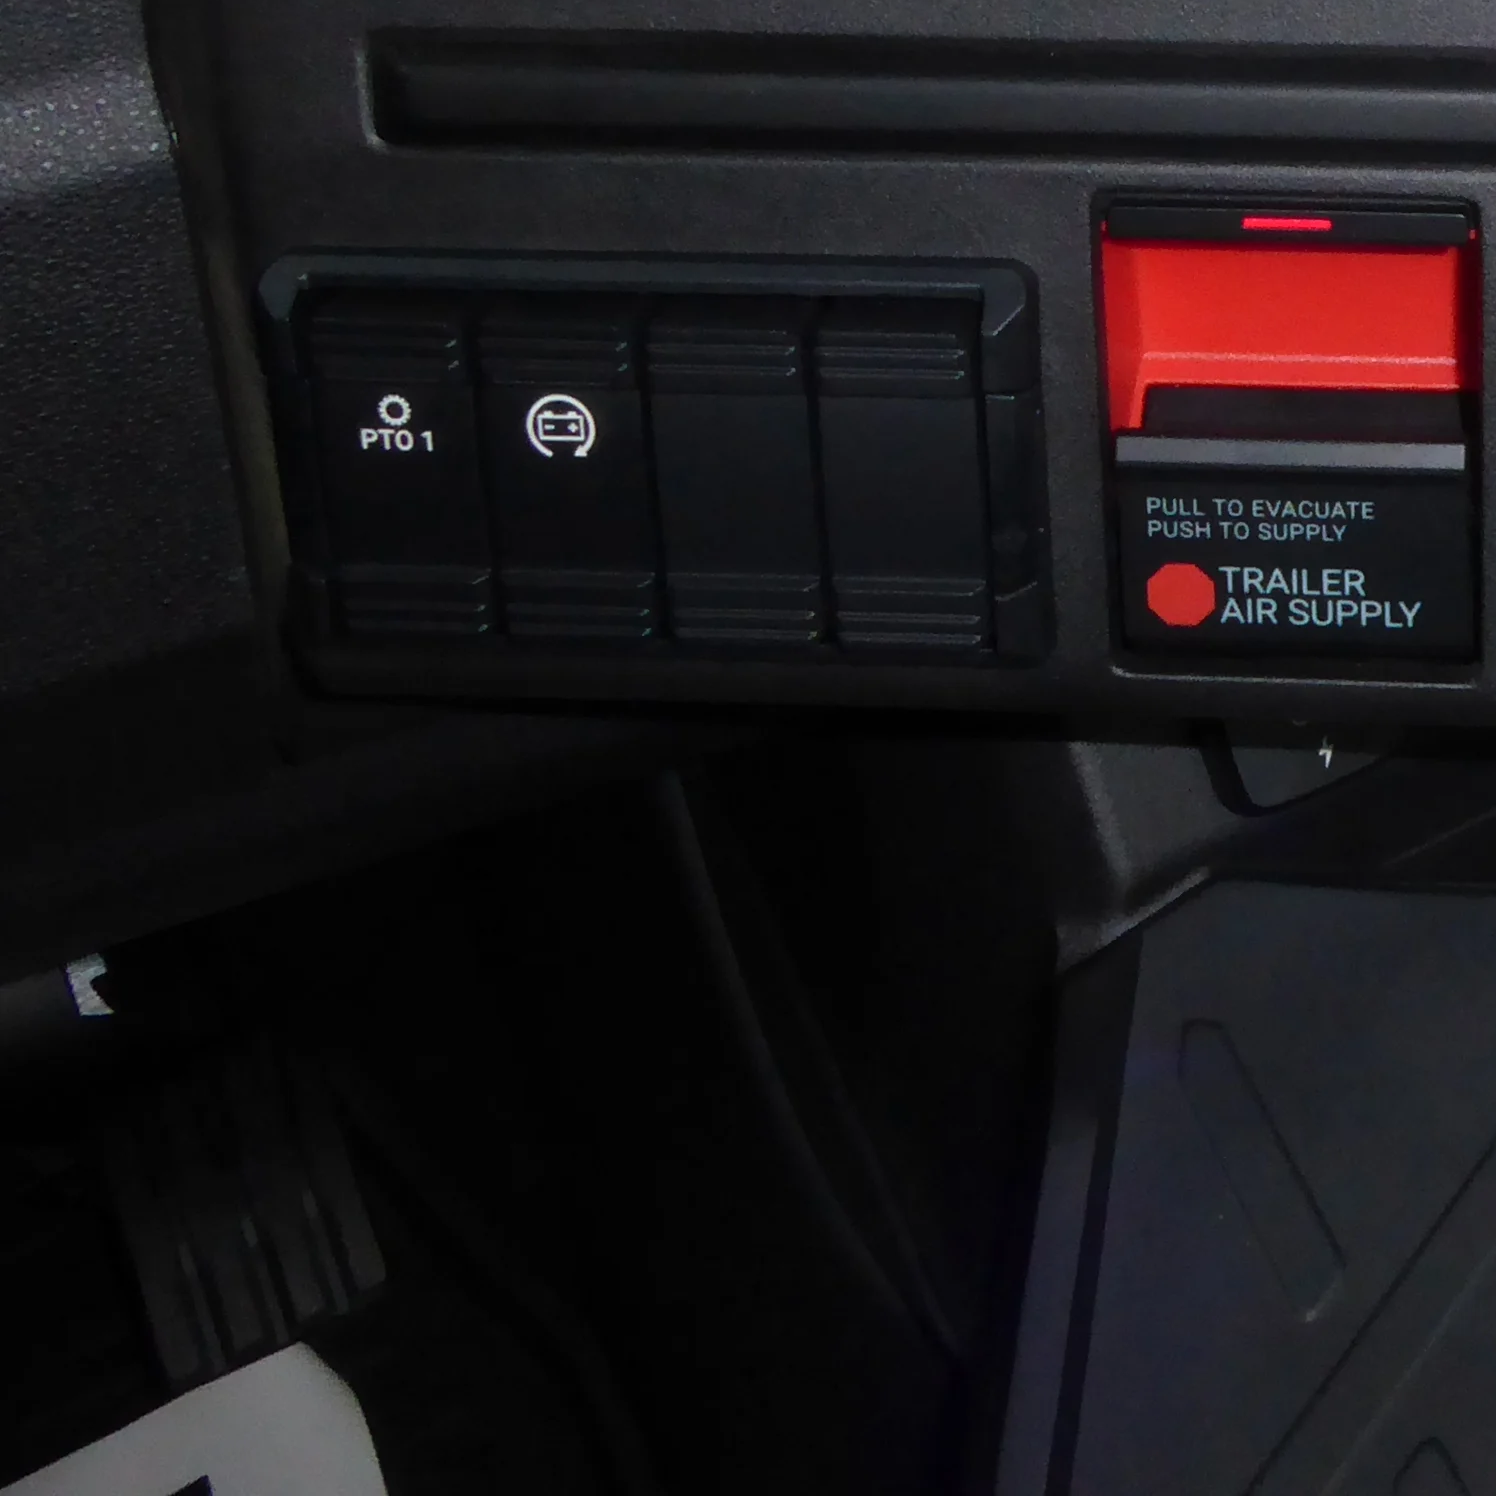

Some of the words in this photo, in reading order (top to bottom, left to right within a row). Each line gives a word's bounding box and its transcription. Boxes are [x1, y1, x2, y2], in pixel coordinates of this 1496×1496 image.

[360, 427, 414, 451] PTO
[420, 430, 434, 452] 1
[1146, 497, 1206, 516] PULL
[1212, 498, 1244, 517] TO
[1252, 499, 1375, 520] EVACUATE
[1147, 520, 1211, 540] PUSH
[1219, 521, 1249, 540] TO
[1258, 522, 1347, 542] SUPPLY
[1219, 566, 1366, 596] TRAILER
[1220, 598, 1278, 625] AIR
[1288, 600, 1421, 628] SUPPLY
